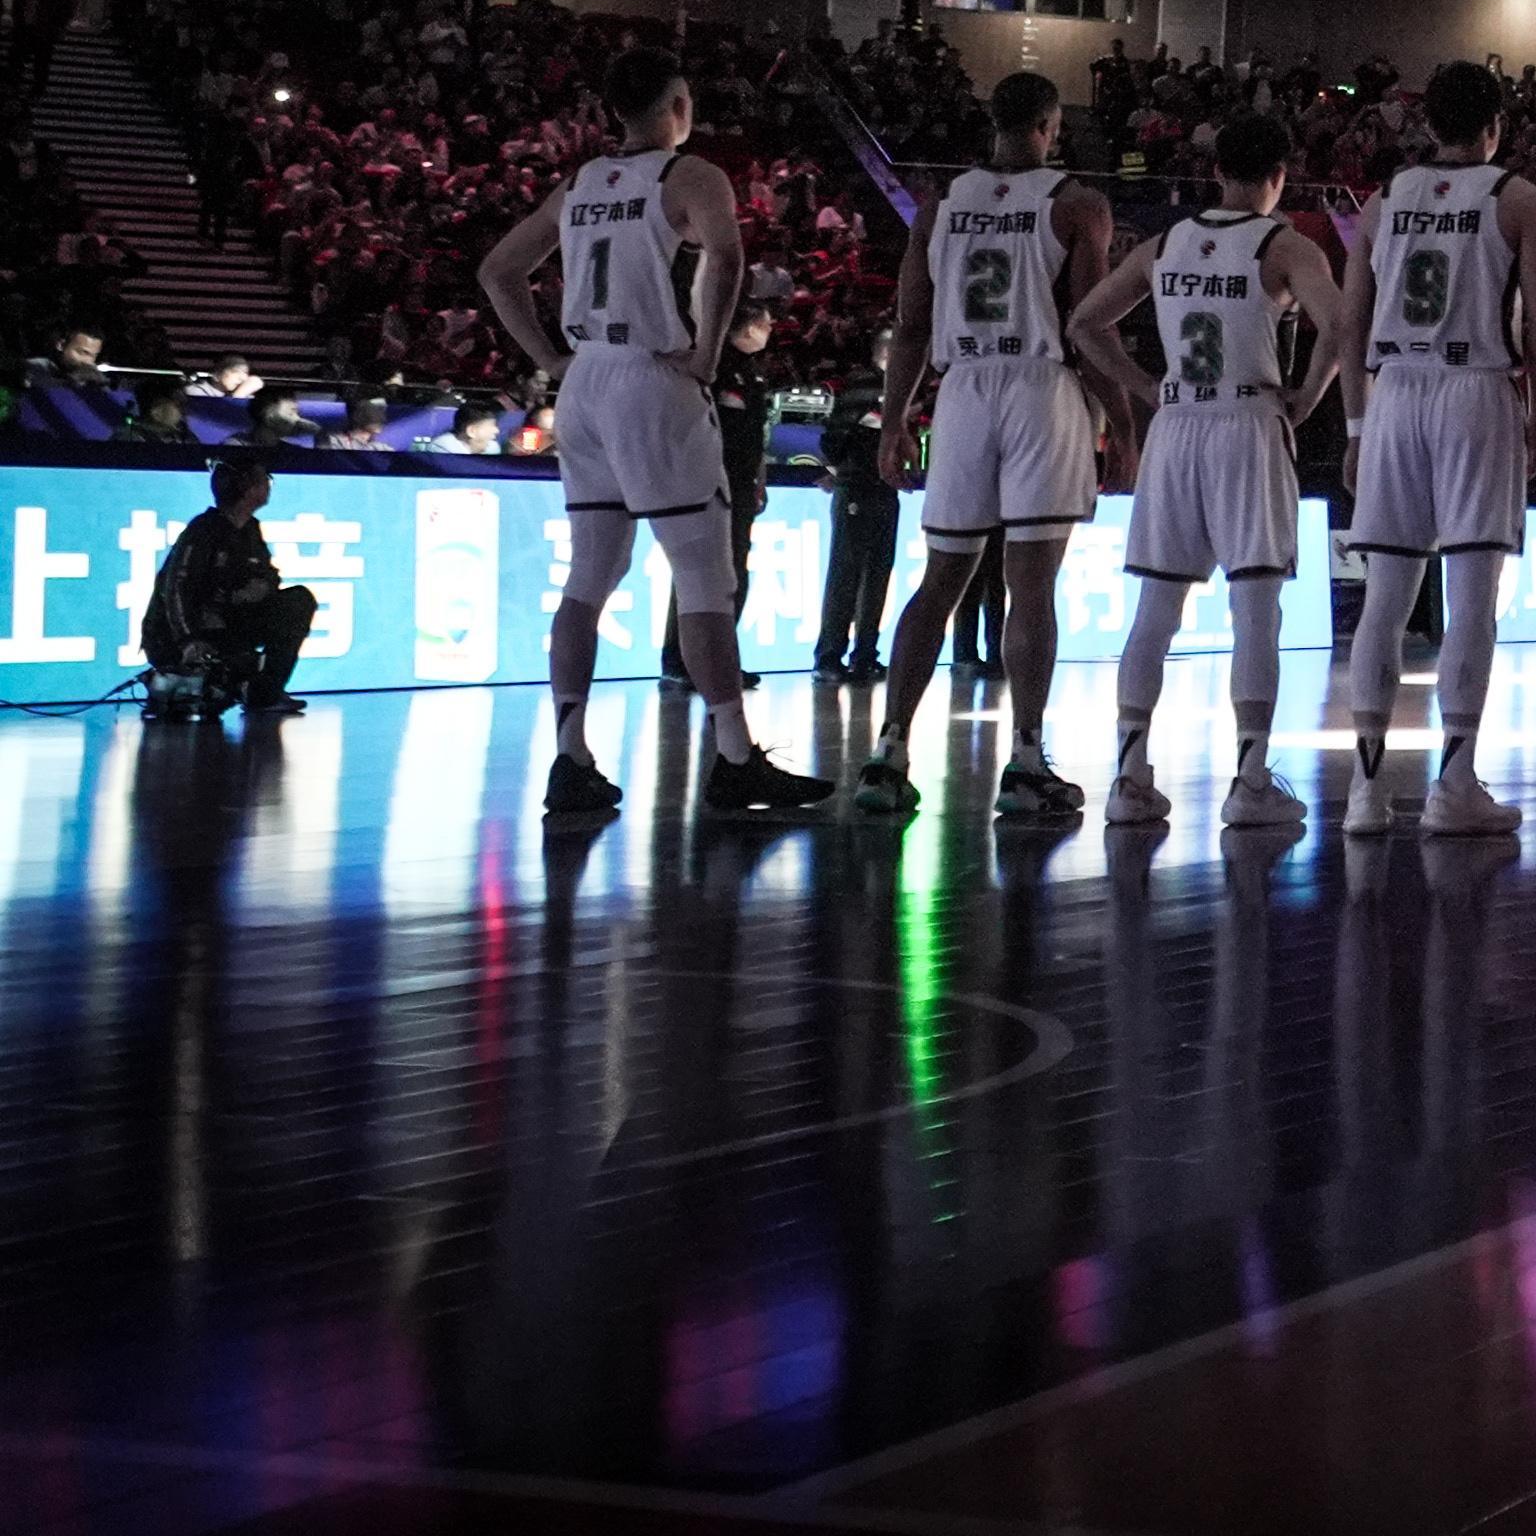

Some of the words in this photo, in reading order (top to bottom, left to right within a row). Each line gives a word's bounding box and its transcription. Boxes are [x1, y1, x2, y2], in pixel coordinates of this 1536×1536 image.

[571, 197, 647, 227] 辽宁本钢
[950, 210, 1036, 235] 辽宁本钢
[1392, 210, 1480, 236] 辽宁本钢
[590, 236, 611, 311] 1
[964, 248, 1012, 323] 2
[1161, 272, 1248, 299] 辽宁本钢
[1403, 249, 1450, 328] 9
[1181, 311, 1224, 386] 3
